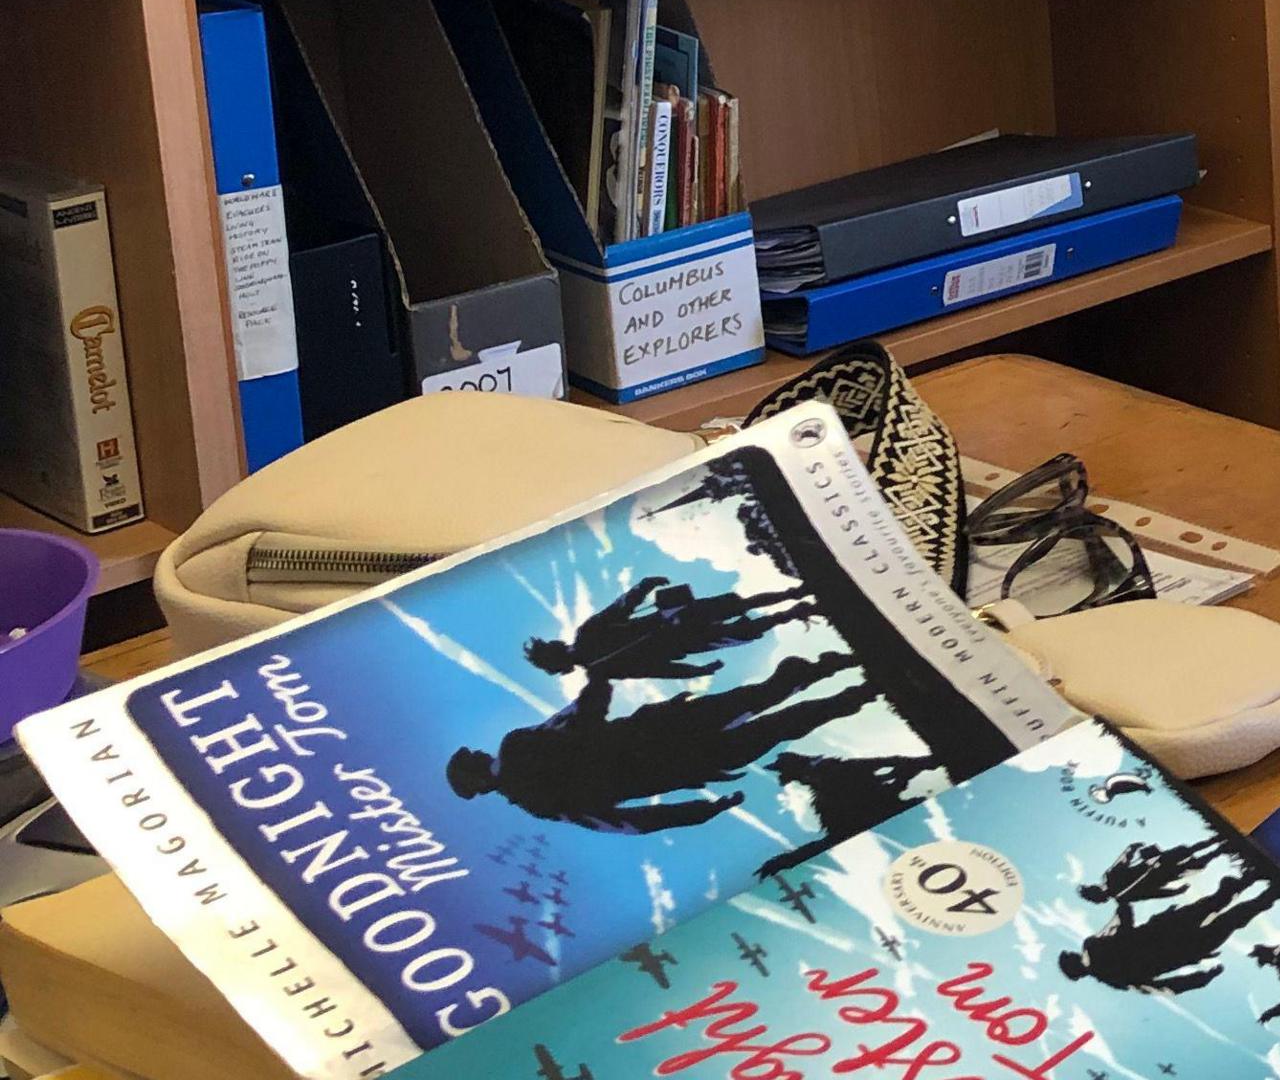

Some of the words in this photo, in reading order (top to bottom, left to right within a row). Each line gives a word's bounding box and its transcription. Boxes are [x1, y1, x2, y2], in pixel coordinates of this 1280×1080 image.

[652, 114, 669, 207] CONQUERORS
[619, 261, 725, 306] COLUMBUS
[623, 310, 665, 334] AND
[677, 288, 733, 319] OTHER
[70, 305, 117, 414] Camelot
[623, 313, 743, 366] EXPLORERS
[634, 375, 684, 397] BANKERS
[685, 368, 708, 382] BOX
[806, 461, 890, 576] CLASSICS
[892, 585, 974, 664] MODERN
[257, 653, 348, 758] Tom
[980, 672, 1056, 743] UFFIN
[70, 717, 228, 906] MAGORIAN
[334, 763, 471, 894] Mister
[1070, 797, 1128, 828] PUFFIN
[160, 679, 512, 1038] GOODNIGHT
[969, 847, 1018, 887] EDITION
[936, 962, 1097, 1080] Tom
